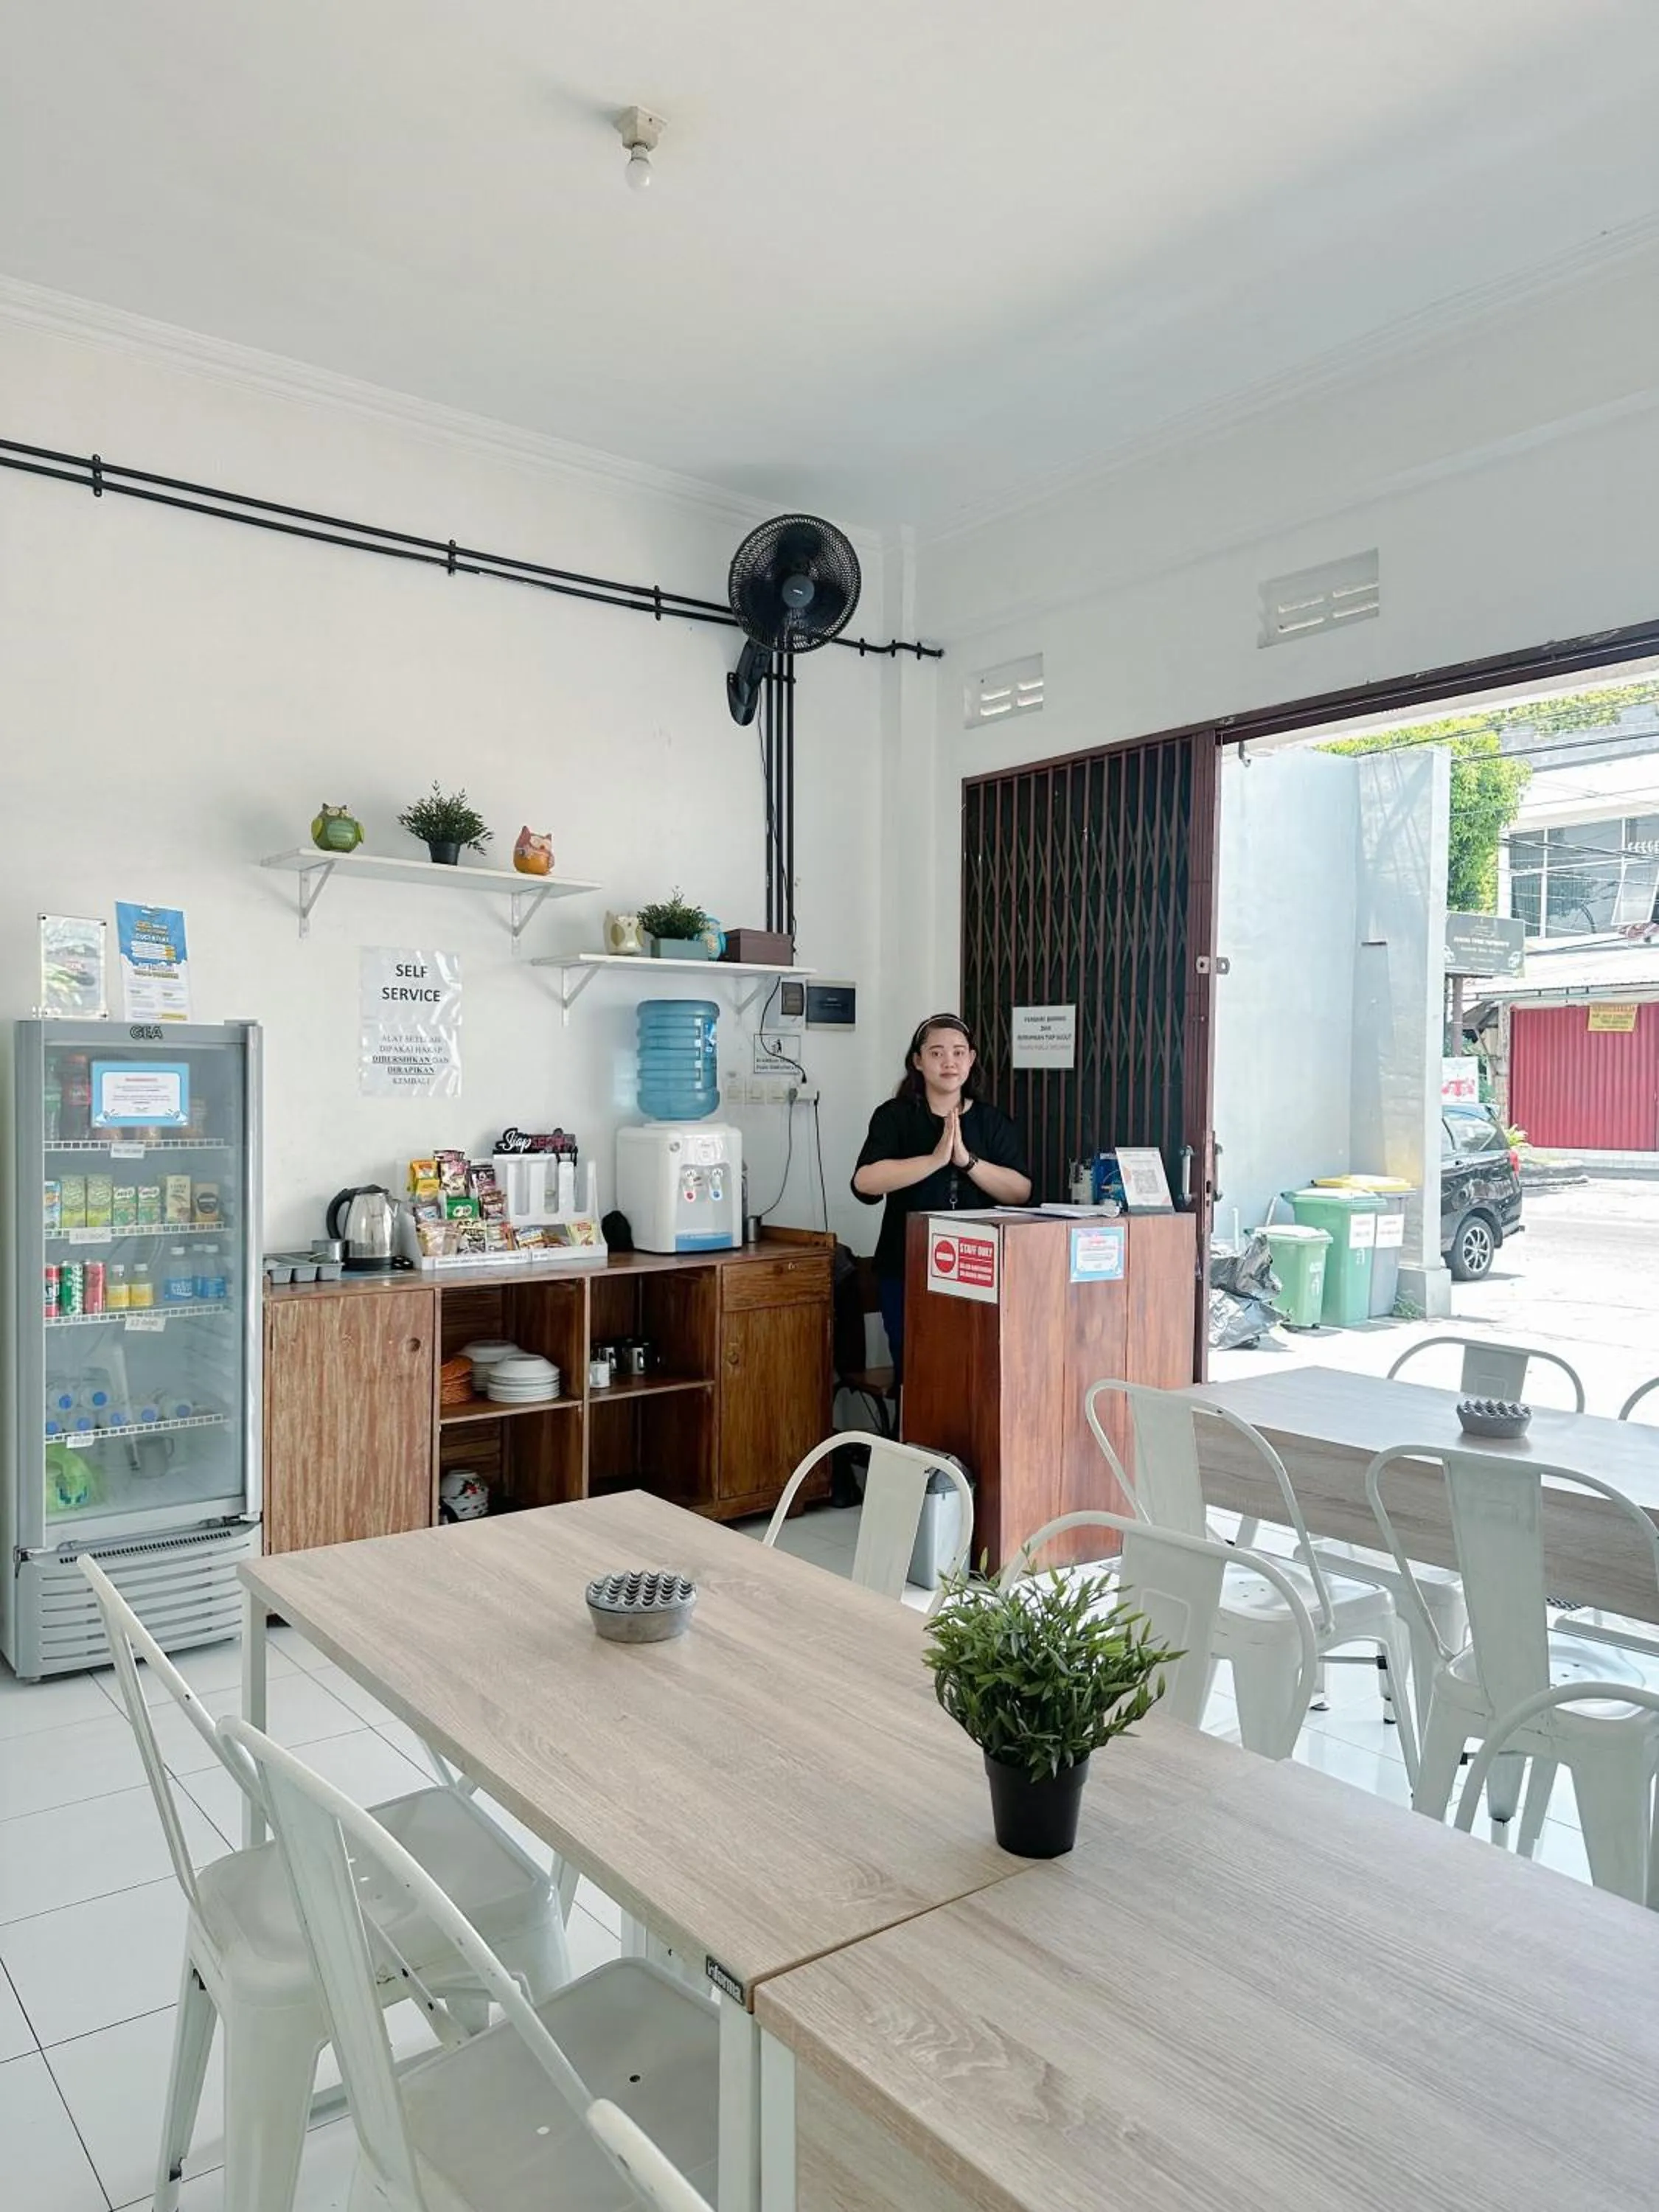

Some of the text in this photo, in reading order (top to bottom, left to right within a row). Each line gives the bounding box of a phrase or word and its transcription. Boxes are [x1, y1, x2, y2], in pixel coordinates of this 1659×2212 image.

[395, 964, 428, 978] SELF
[382, 987, 441, 1002] SERVICE
[130, 1025, 163, 1040] GEA
[498, 1130, 532, 1153] Siap
[960, 1243, 992, 1257] STAFF ONLY
